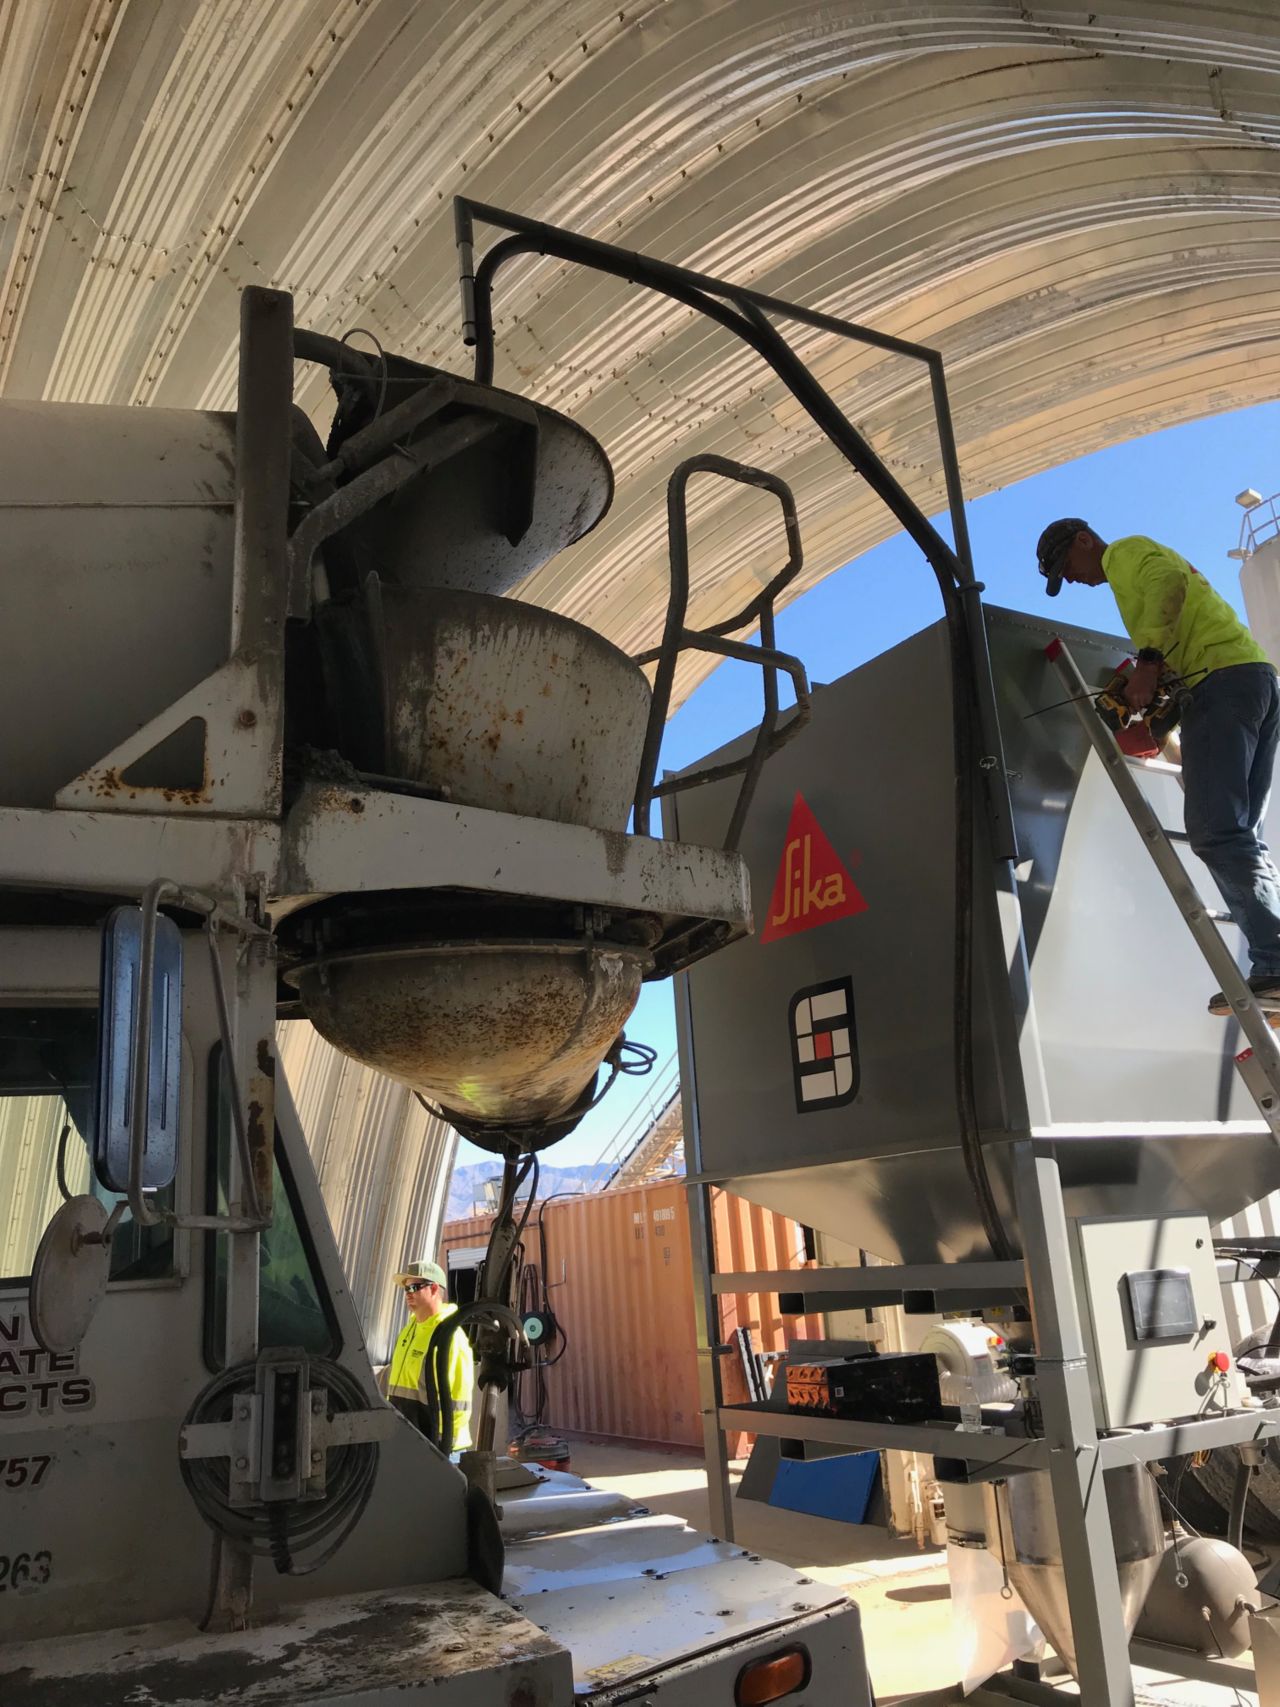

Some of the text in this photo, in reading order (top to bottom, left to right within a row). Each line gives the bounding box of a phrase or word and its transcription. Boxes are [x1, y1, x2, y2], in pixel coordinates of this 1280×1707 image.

[772, 833, 847, 927] Sika
[0, 1346, 76, 1375] ATE
[0, 1378, 92, 1412] CTS
